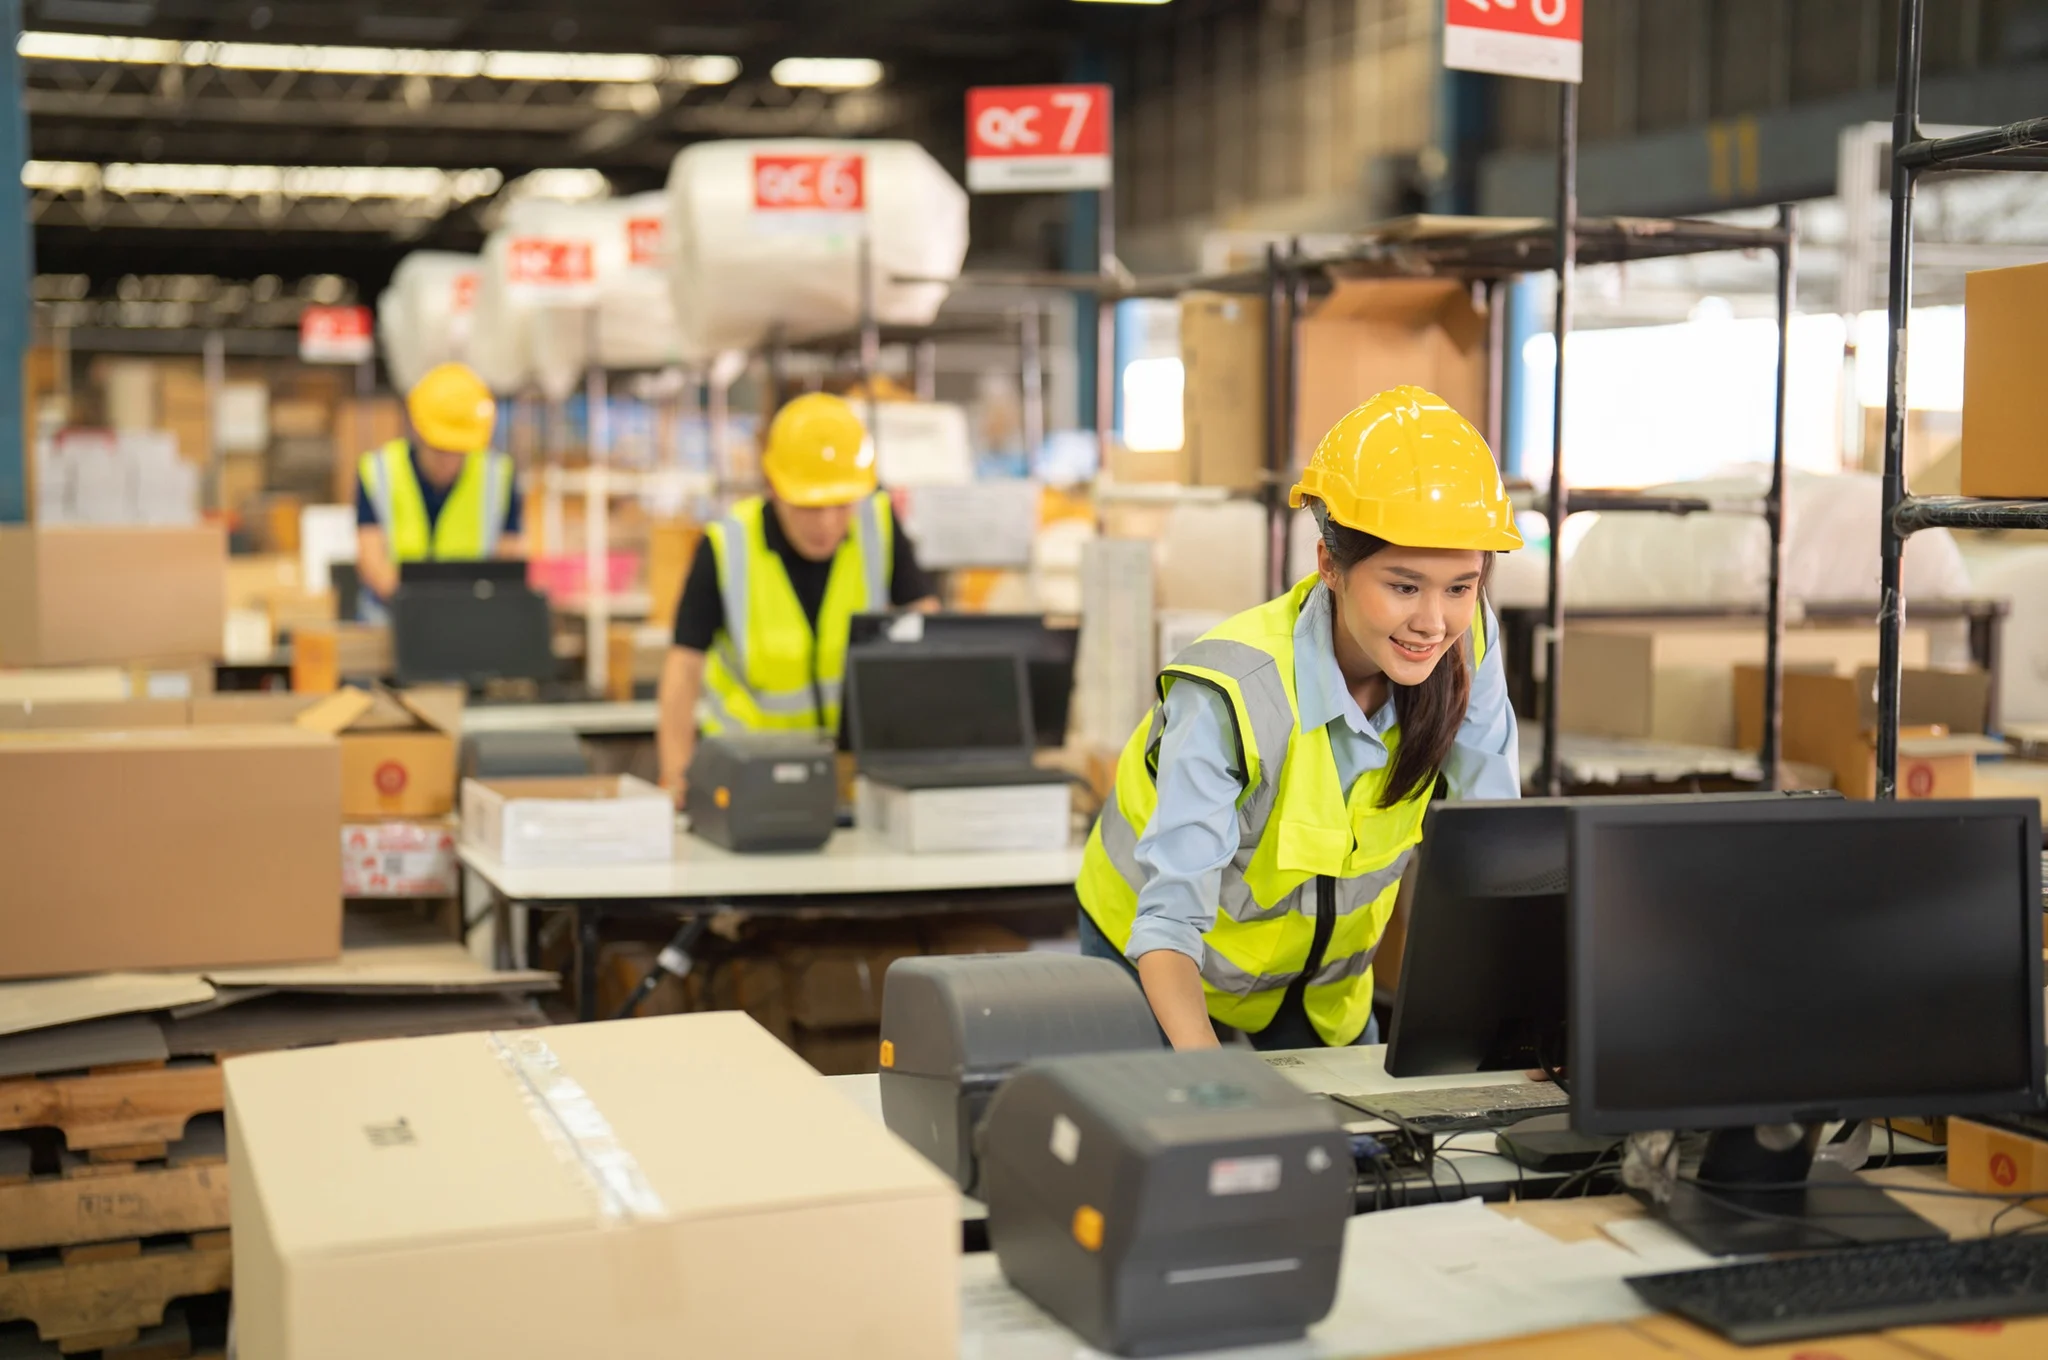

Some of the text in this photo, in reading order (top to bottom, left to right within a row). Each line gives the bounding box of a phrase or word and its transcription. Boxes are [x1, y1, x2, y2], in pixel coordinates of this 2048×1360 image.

[976, 92, 1093, 152] QC 7
[757, 154, 858, 210] QC 6
